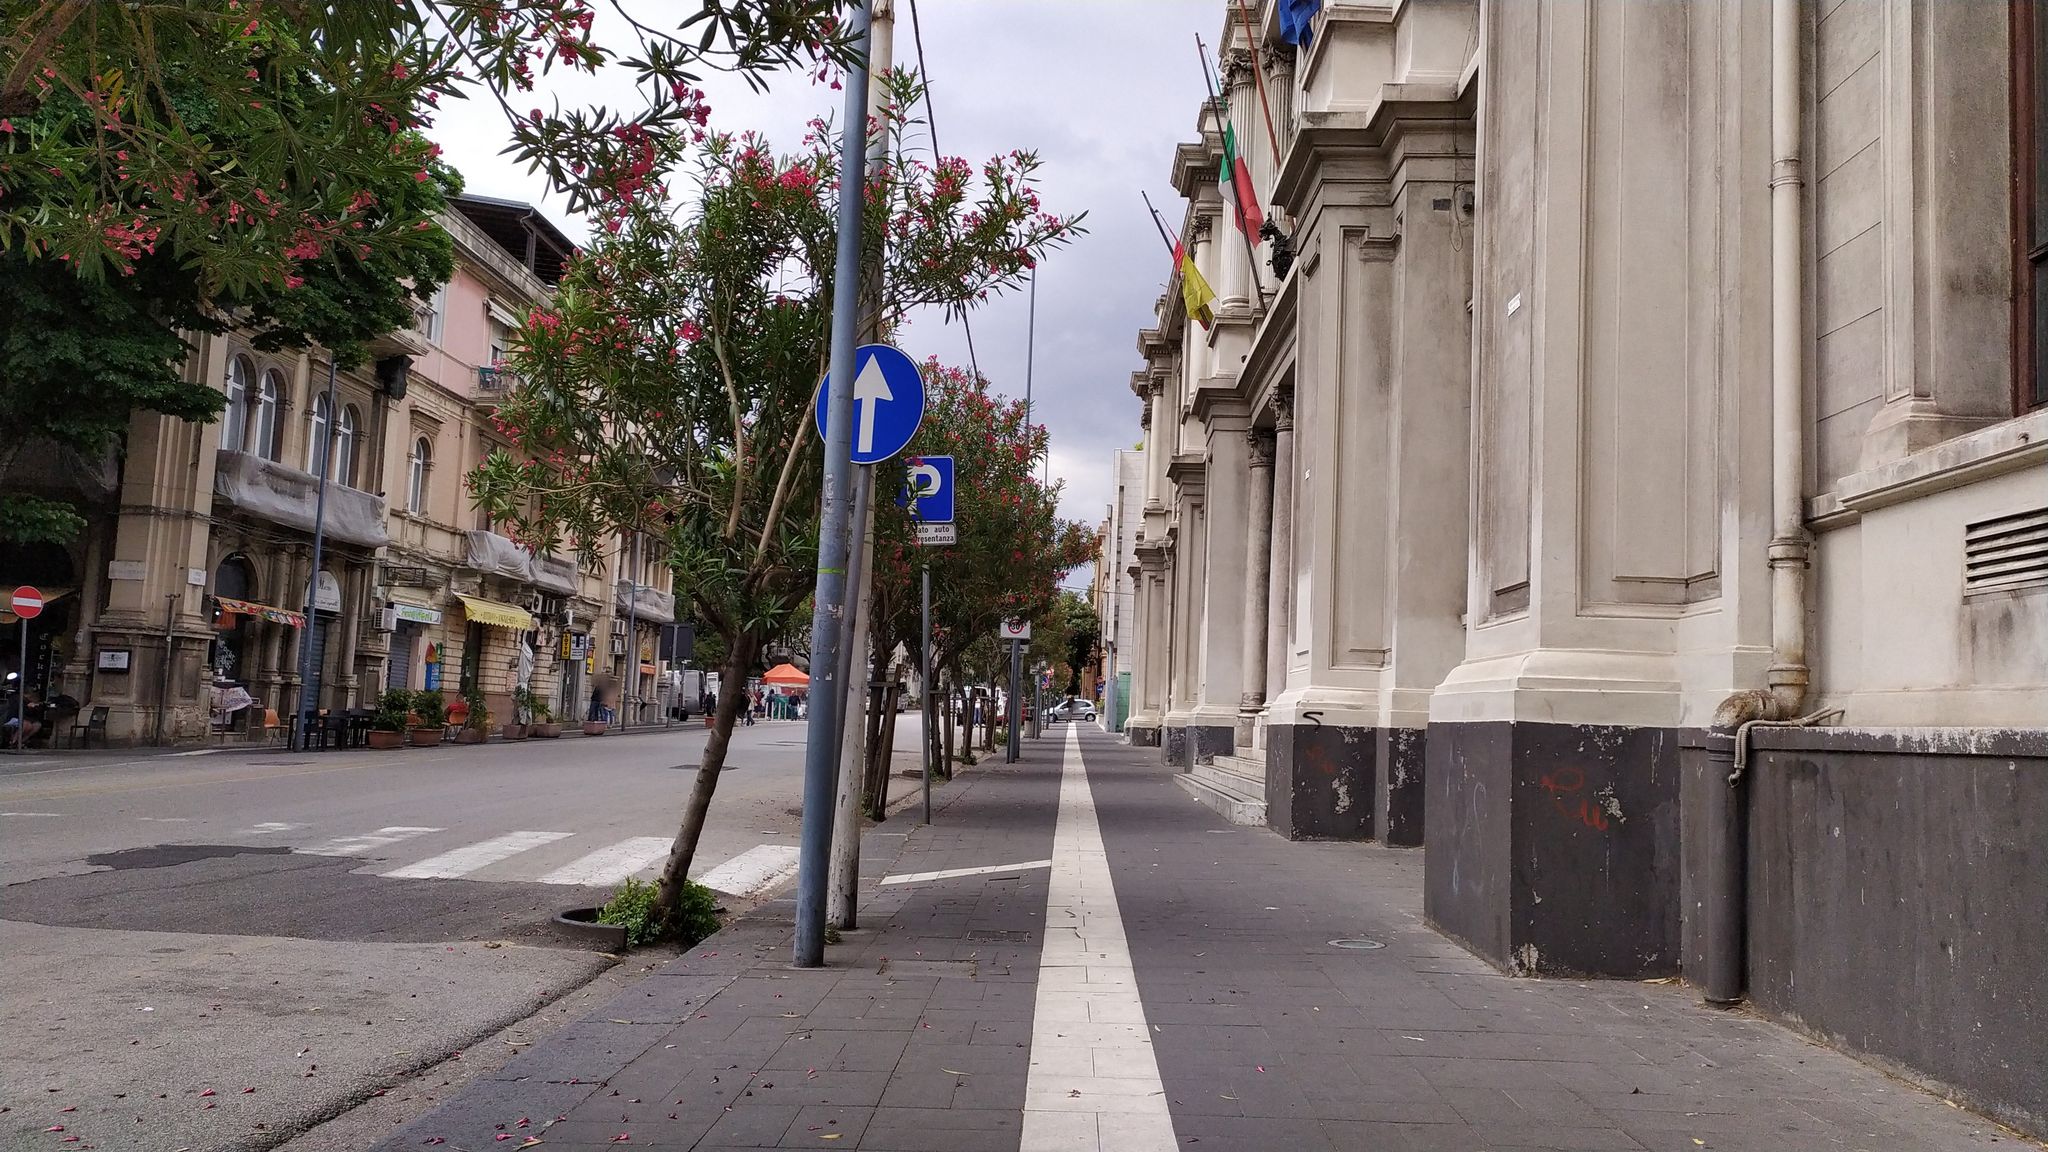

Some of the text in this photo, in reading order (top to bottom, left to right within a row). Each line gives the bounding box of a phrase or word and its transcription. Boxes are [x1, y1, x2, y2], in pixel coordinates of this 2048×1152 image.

[907, 464, 941, 515] P
[934, 525, 950, 534] auto
[917, 534, 954, 542] resentanza
